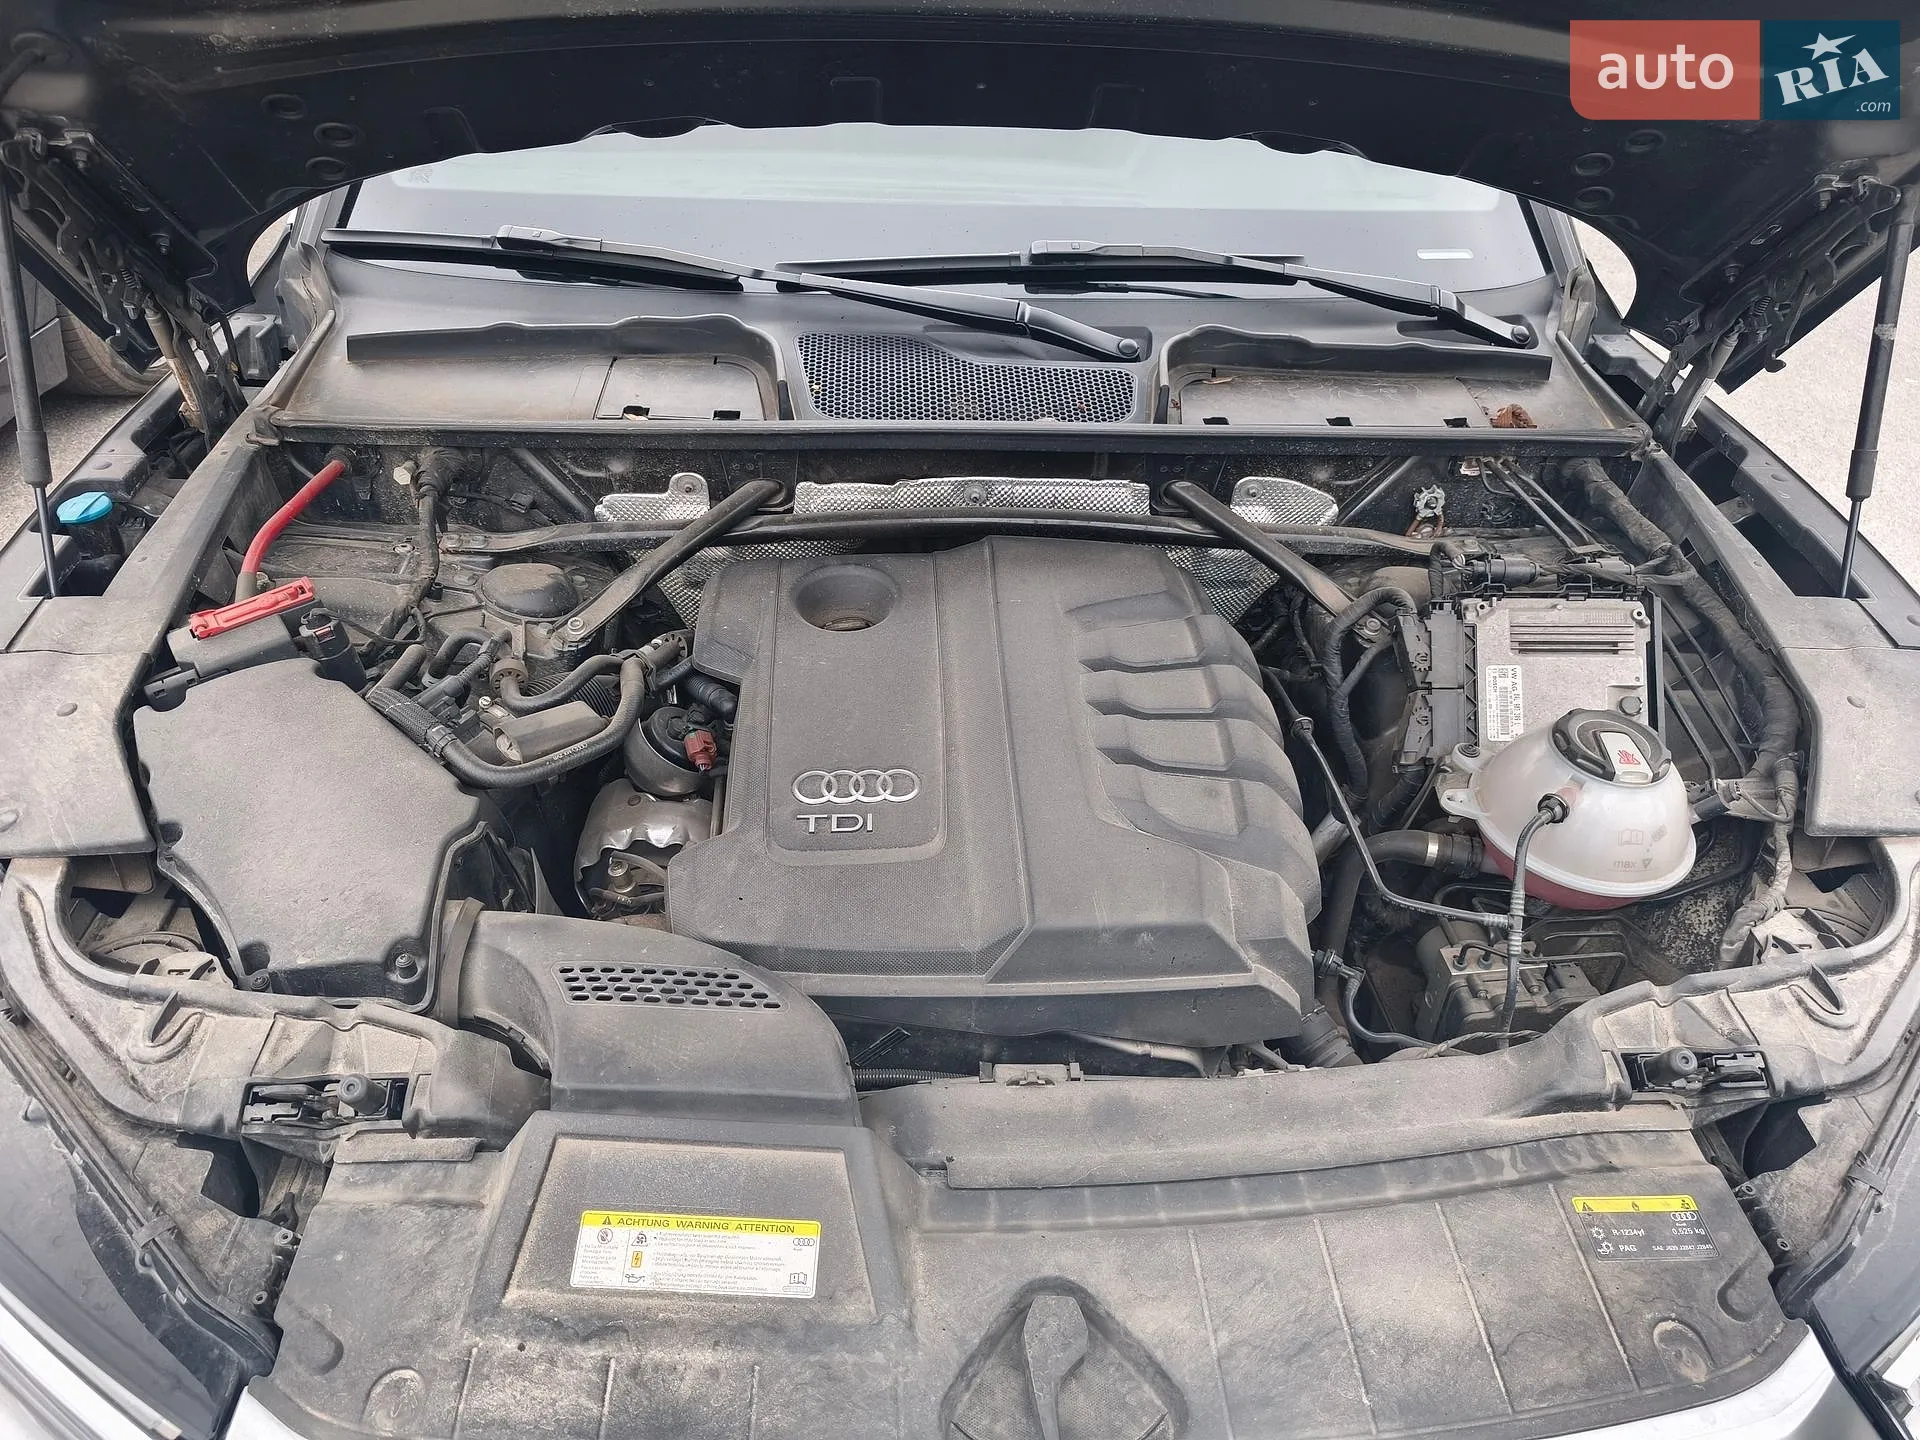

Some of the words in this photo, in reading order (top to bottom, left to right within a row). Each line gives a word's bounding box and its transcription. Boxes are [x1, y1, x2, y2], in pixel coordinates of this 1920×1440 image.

[796, 813, 873, 834] TDI
[617, 1217, 670, 1228] ACHTUNG
[676, 1219, 729, 1231] WARNING
[735, 1222, 795, 1234] ATTENTION
[1671, 1228, 1693, 1236] 0,525
[1694, 1228, 1705, 1236] kg
[1618, 1244, 1638, 1252] PAG
